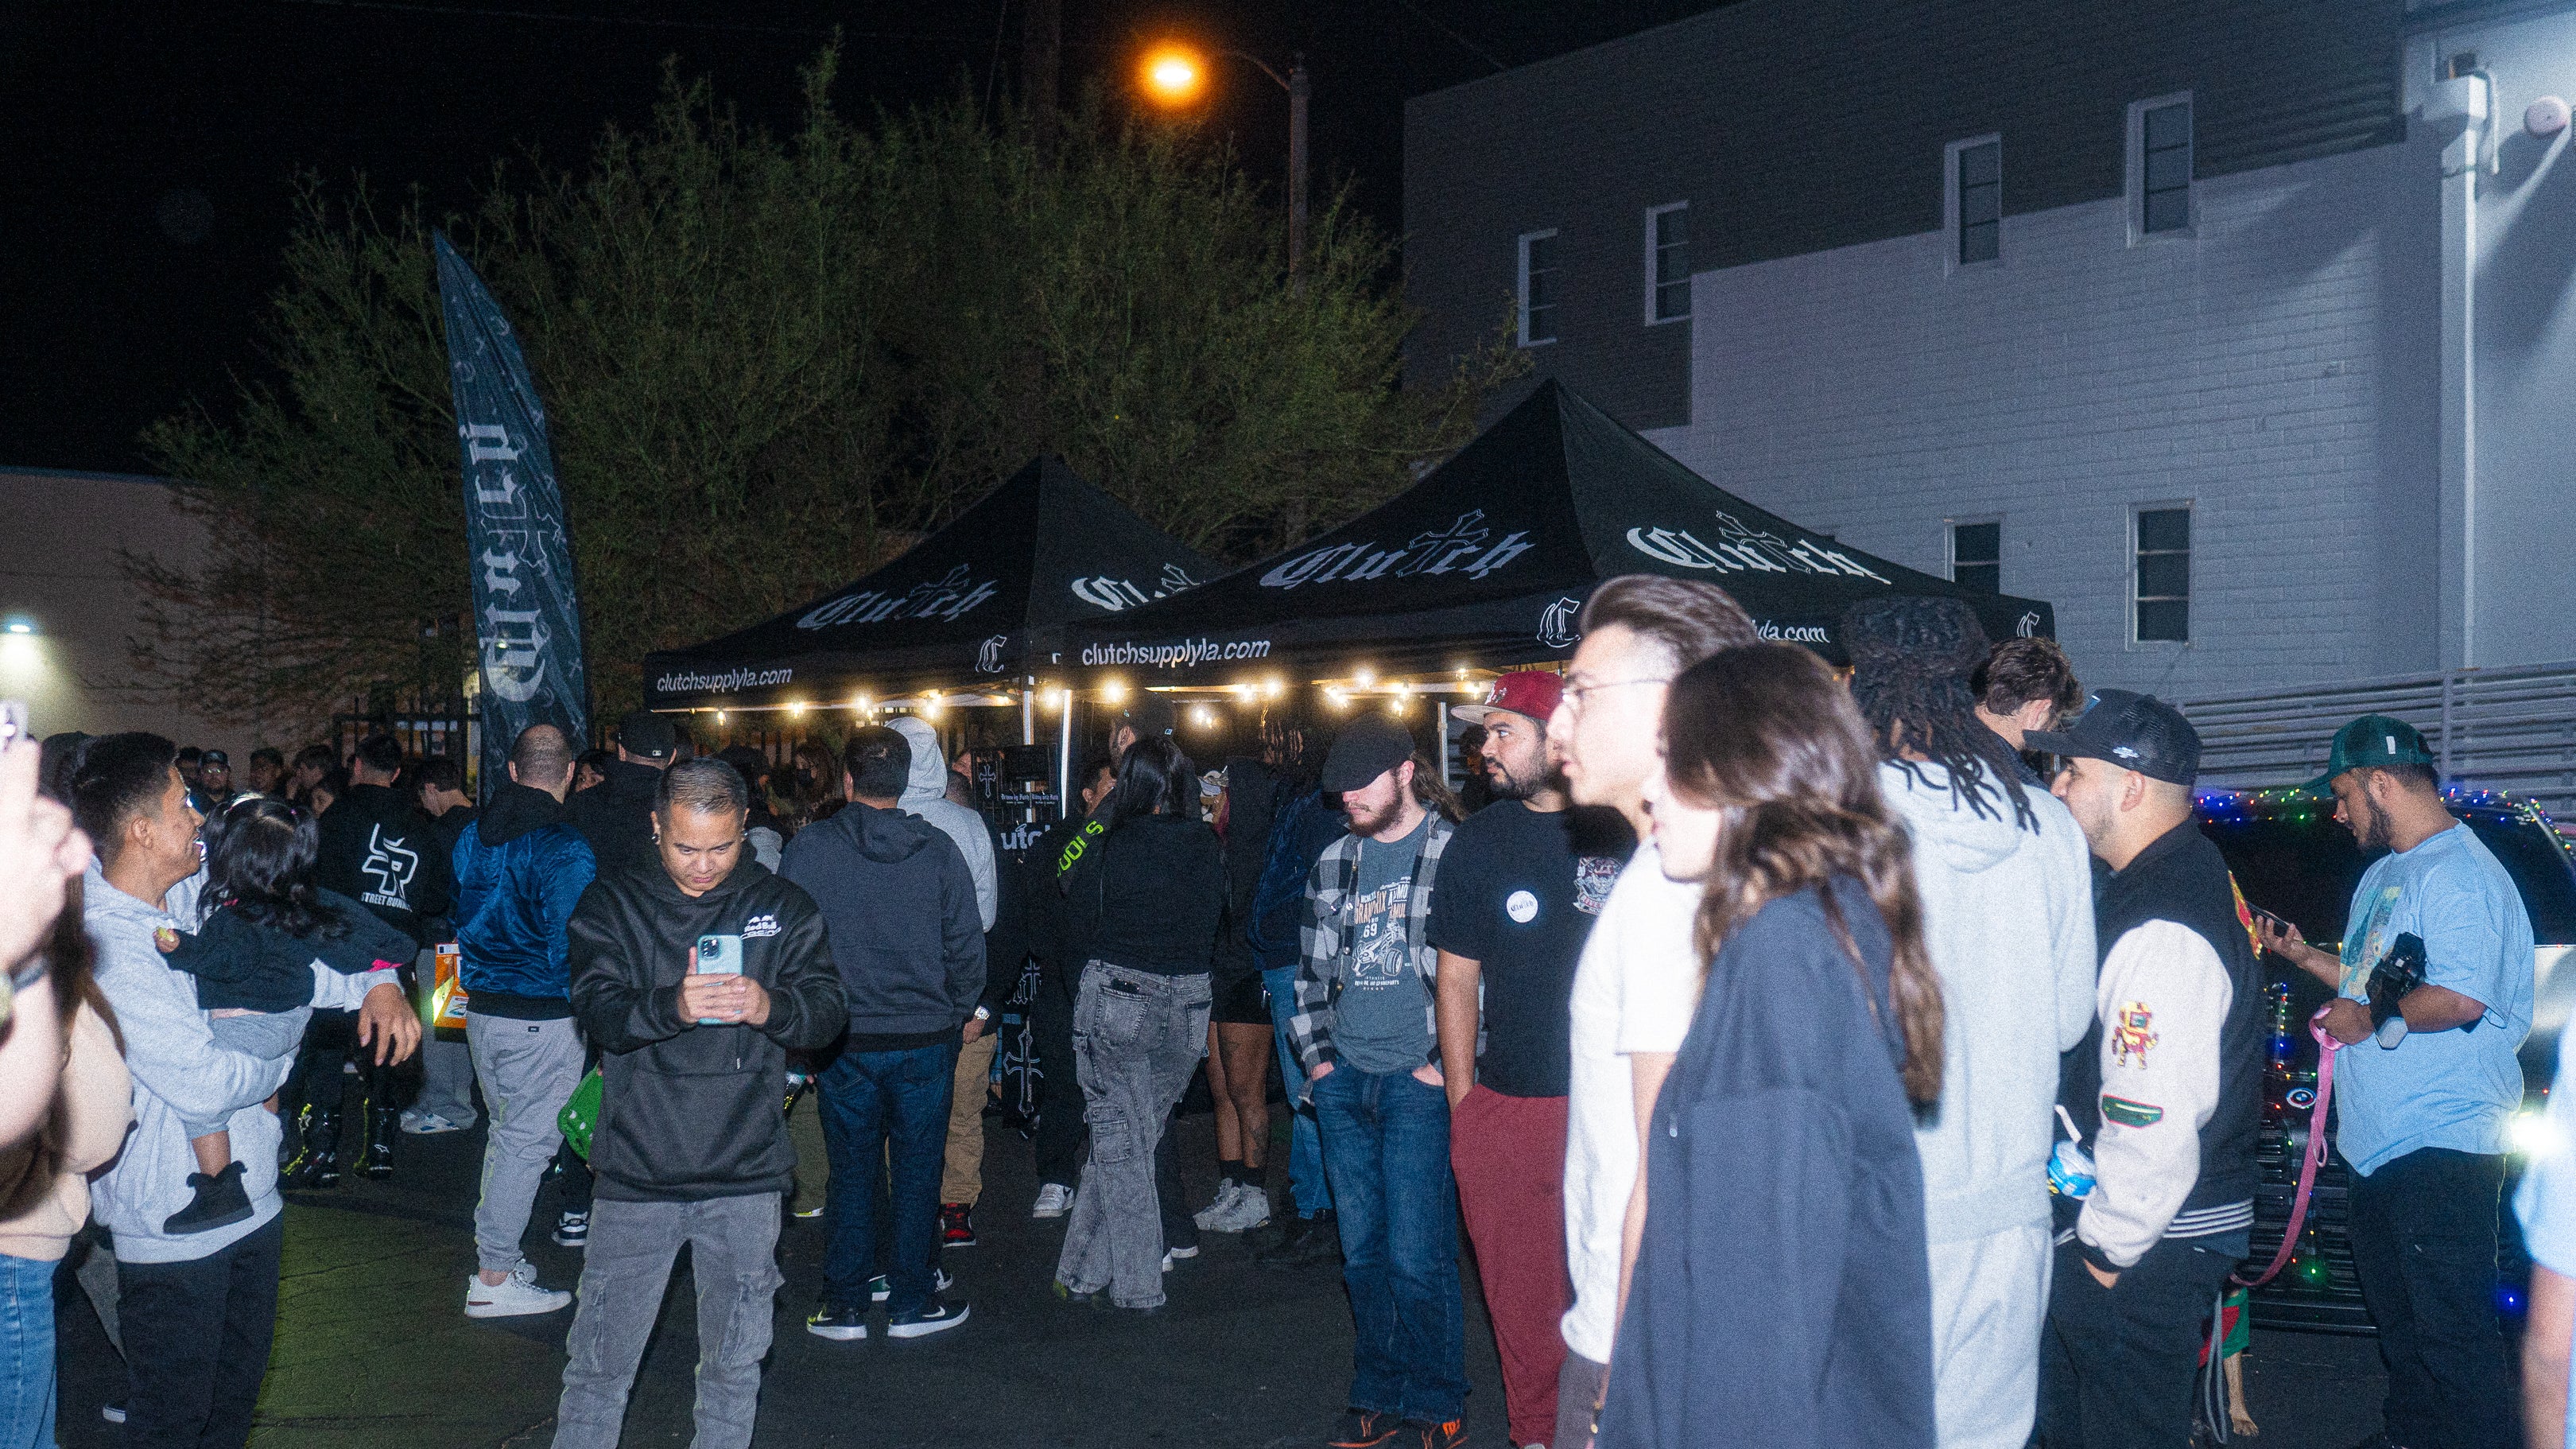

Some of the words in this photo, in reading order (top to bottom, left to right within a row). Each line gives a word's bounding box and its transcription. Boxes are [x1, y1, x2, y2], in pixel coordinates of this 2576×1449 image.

[1259, 508, 1535, 590] Clutch
[1626, 510, 1891, 585] Clutch
[796, 563, 999, 630] Clutch
[1081, 637, 1271, 669] clutchsupplyla.com
[656, 666, 793, 693] clutchsupplyla.com
[361, 892, 387, 905] STREET
[1363, 922, 1378, 938] 69
